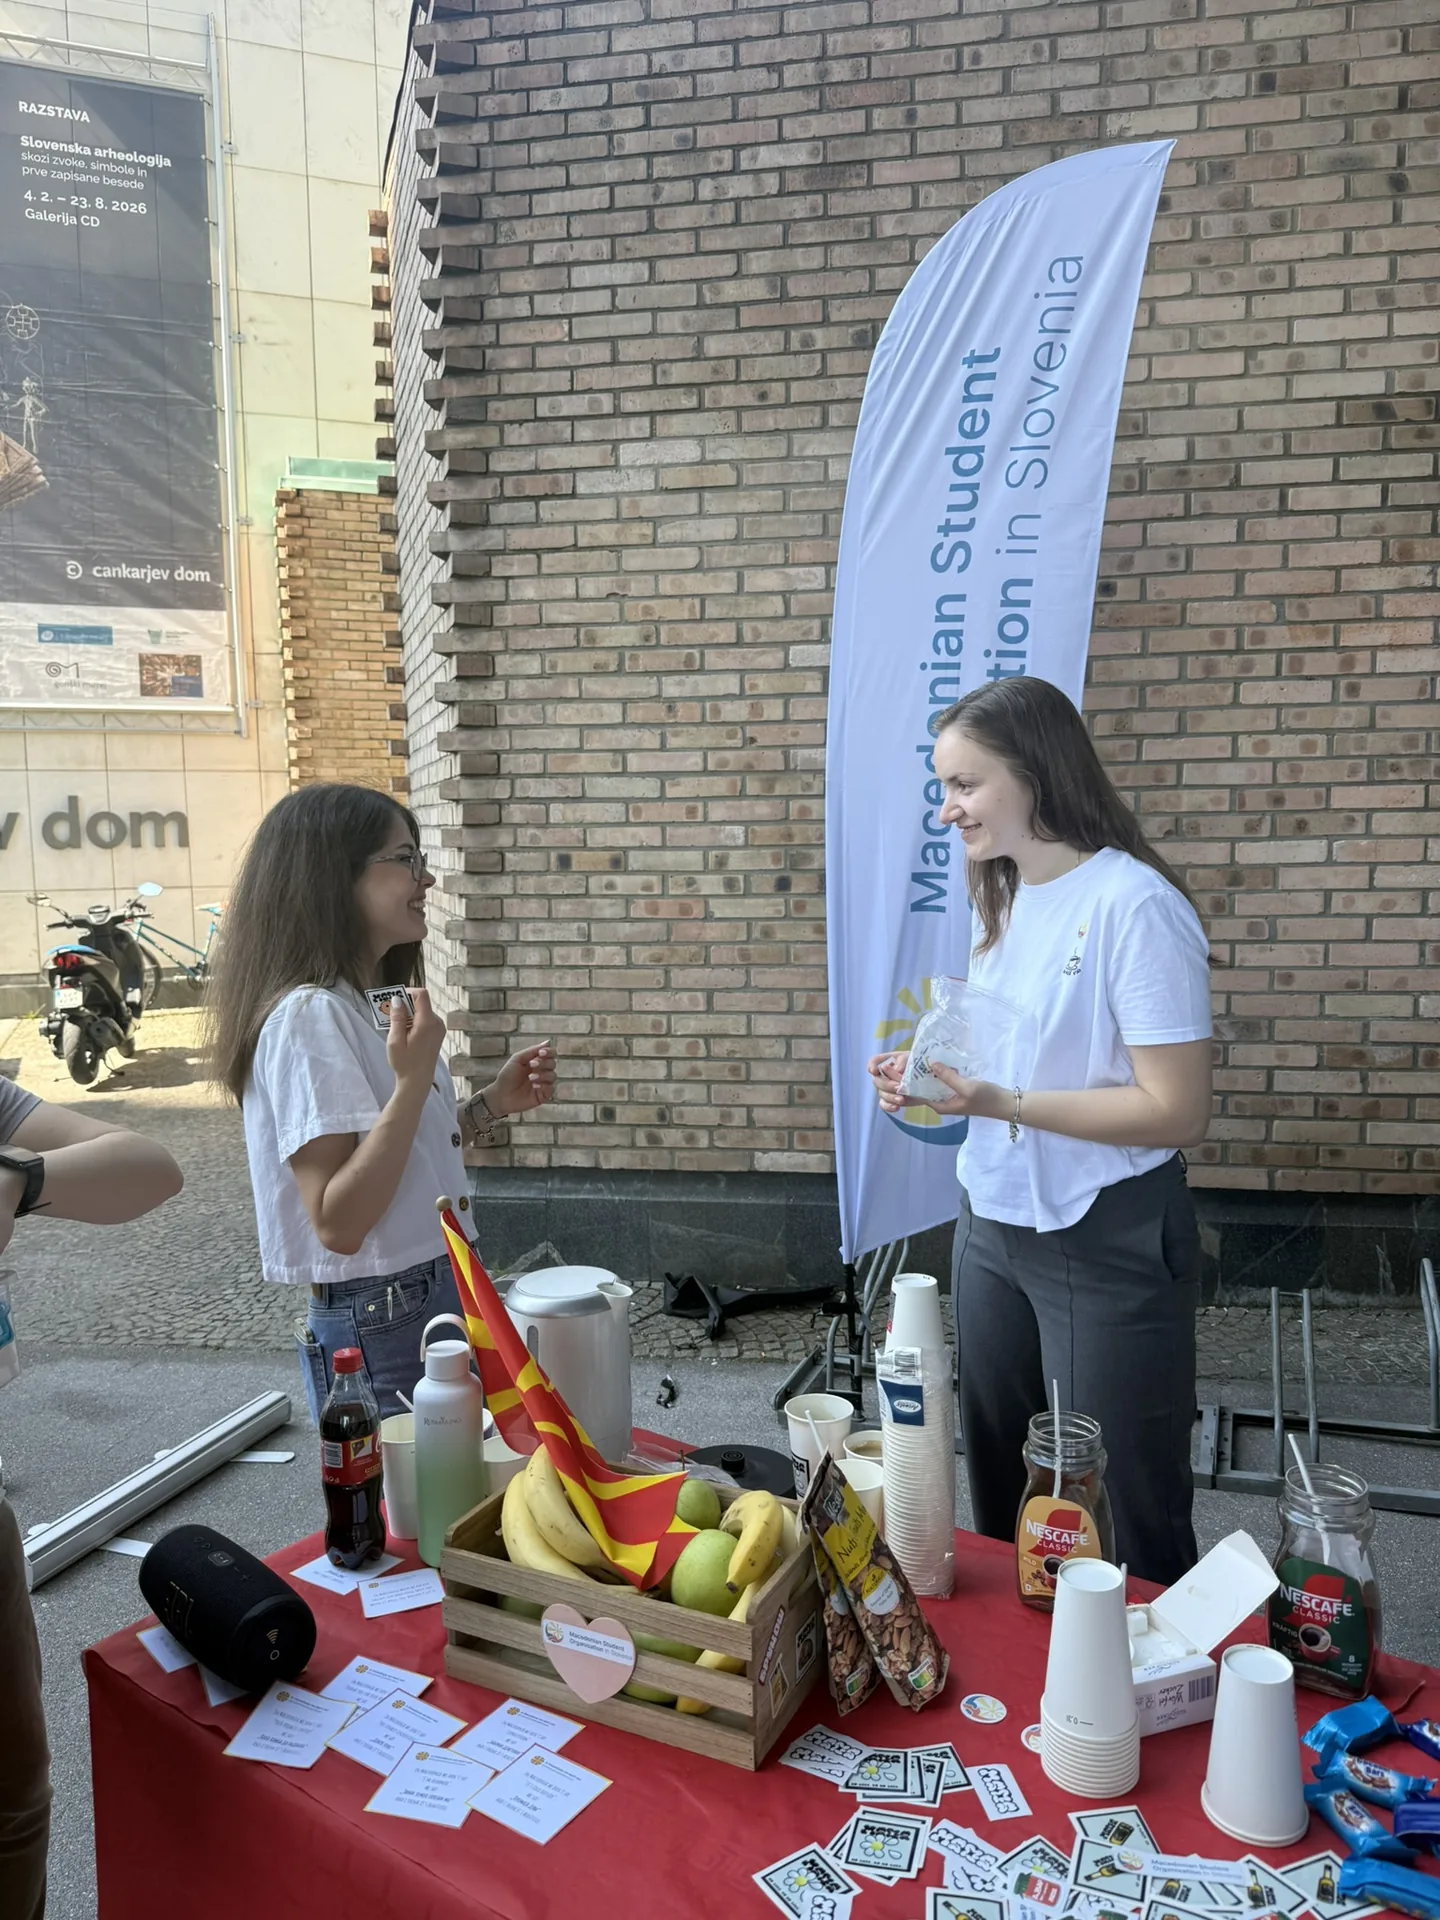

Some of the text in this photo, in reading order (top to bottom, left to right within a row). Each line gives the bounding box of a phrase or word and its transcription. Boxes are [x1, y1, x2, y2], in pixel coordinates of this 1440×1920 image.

[18, 100, 91, 123] RAZSTAVA
[20, 135, 172, 168] Slovenska arheologija
[21, 151, 50, 164] skozi
[90, 160, 135, 177] simbole
[137, 166, 148, 178] in
[22, 166, 145, 190] prve zapisane besede
[24, 190, 37, 202] 4.
[40, 191, 53, 203] 2.
[70, 195, 92, 209] 23.
[95, 197, 108, 210] 8.
[111, 200, 148, 214] 2026
[24, 208, 100, 227] Galerija CD
[1005, 254, 1084, 491] Slovenia
[931, 347, 1001, 573] Student
[996, 514, 1041, 556] in
[92, 564, 211, 583] cankarjev dom
[42, 795, 190, 850] dom
[1036, 1539, 1078, 1554] CLASSIC
[1293, 1605, 1341, 1624] CLASSIC
[1348, 1655, 1356, 1663] 8
